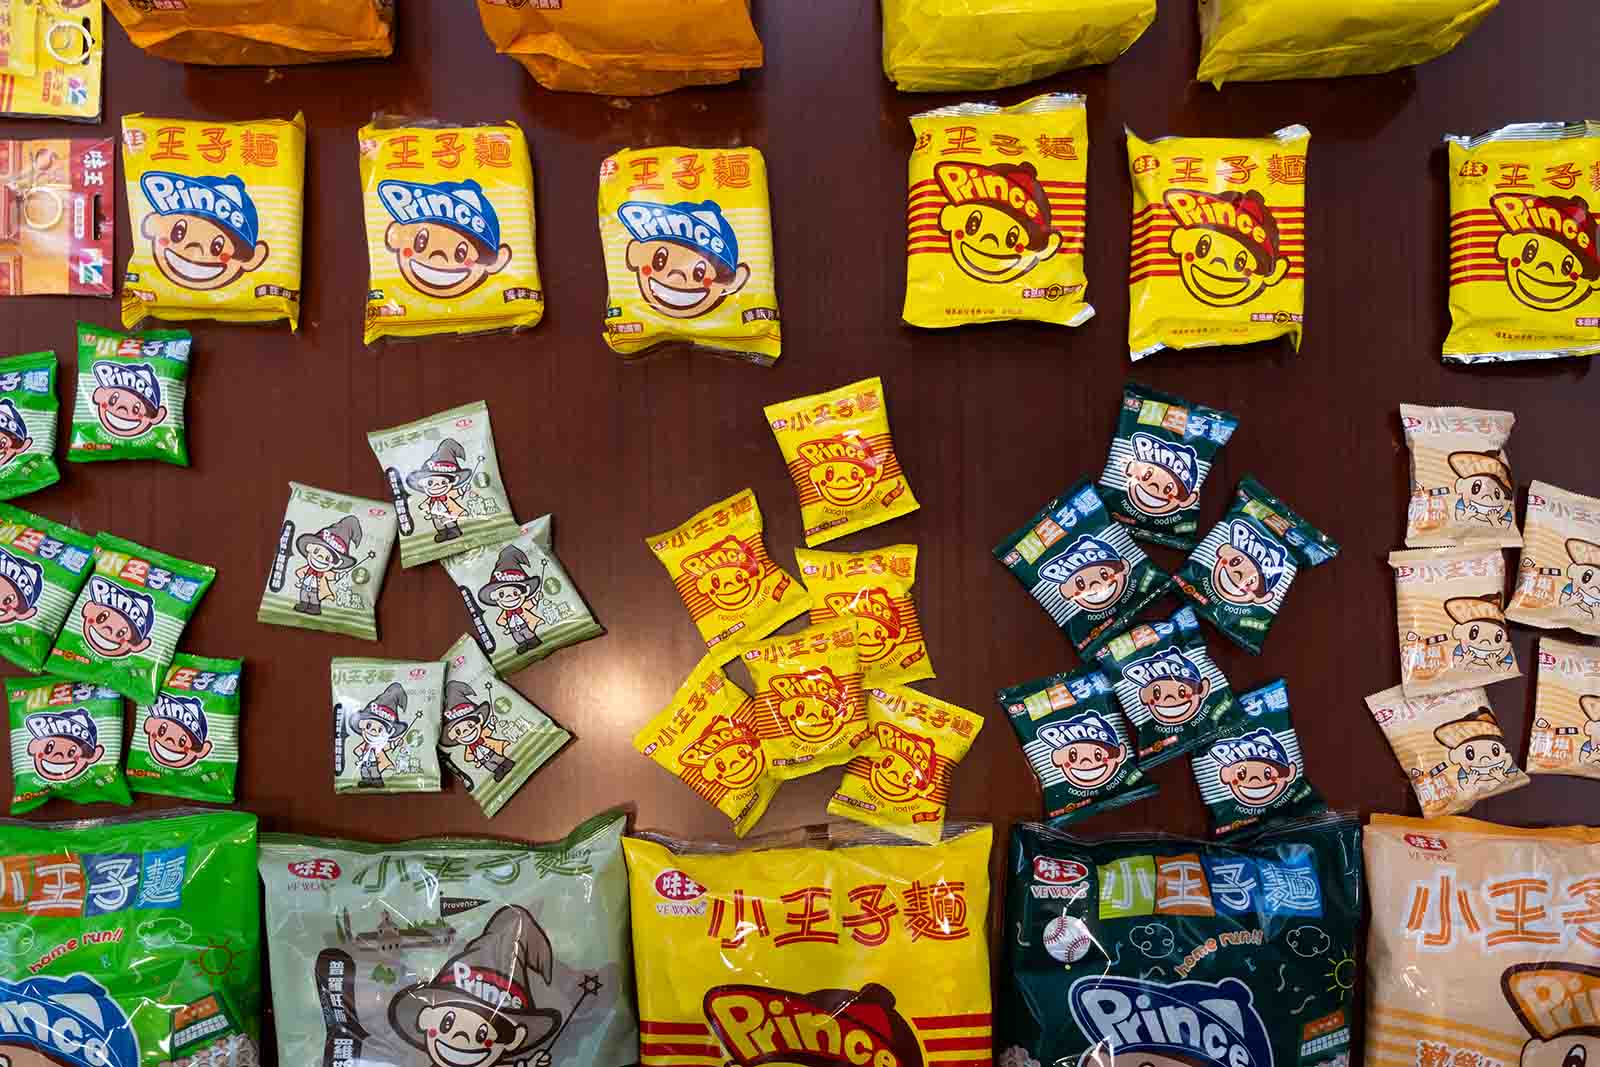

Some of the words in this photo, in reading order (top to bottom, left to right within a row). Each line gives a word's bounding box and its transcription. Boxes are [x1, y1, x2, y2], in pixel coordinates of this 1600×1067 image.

[150, 127, 279, 167] 王子麵
[385, 133, 512, 169] 王子麵
[941, 126, 1078, 160] 王子麵
[627, 154, 752, 192] 王子麵
[1168, 154, 1305, 184] 王子麵
[145, 175, 244, 228] Prince
[381, 186, 485, 232] Prince
[938, 166, 1039, 218] Prince
[621, 207, 724, 253] Prince
[1167, 193, 1266, 243] Prince
[1495, 196, 1590, 248] Prince
[95, 365, 155, 398] Prince
[790, 392, 879, 431] 小王子麵
[1138, 400, 1237, 444] 小王子麵
[429, 461, 457, 473] Prince
[801, 442, 866, 465] Prince
[1135, 439, 1190, 480] Prince
[670, 496, 753, 548] 小王子麵
[1016, 488, 1104, 565] 小王子麵
[1122, 499, 1147, 523] noodles
[1153, 514, 1182, 525] oodles
[322, 529, 346, 553] Prince
[96, 552, 203, 604] 小王子麵
[495, 570, 525, 583] Prince
[684, 553, 747, 577] Prince
[822, 556, 912, 581] 小王子麵
[1042, 549, 1108, 581] Prince
[93, 580, 145, 628] Prince
[830, 595, 891, 621] Prince
[1087, 607, 1117, 621] noodles
[1224, 605, 1252, 616] oodles
[765, 629, 855, 663] 小王子麵
[1108, 606, 1198, 660] 小王子麵
[163, 665, 240, 697] 王子麵
[1128, 660, 1190, 685] Prince
[776, 679, 840, 702] Prince
[1026, 672, 1112, 719] 小王子麵
[370, 704, 396, 721] Prince
[445, 705, 474, 720] Prince
[657, 674, 725, 746] 小王子麵
[886, 696, 973, 738] 小王子麵
[1154, 725, 1184, 734] noodles
[1191, 704, 1212, 727] oodles
[33, 717, 89, 740] Prince
[1040, 724, 1108, 747] Prince
[684, 728, 742, 767] Prince
[878, 728, 929, 767] Prince
[1213, 743, 1277, 766] Prince
[1068, 786, 1099, 797] noodles
[1106, 769, 1127, 790] oodles
[1234, 804, 1266, 815] noodles
[0, 856, 186, 911] 小王子麵
[295, 862, 334, 878] 味王
[663, 873, 700, 896] 味王
[1039, 860, 1081, 879] 味王
[1098, 860, 1322, 912] 小王子麵
[442, 899, 478, 911] Provence
[656, 904, 670, 915] VE
[671, 904, 705, 916] WONG
[708, 880, 970, 949] 小王子麵
[29, 938, 79, 973] home
[82, 928, 125, 946] run!!
[1175, 938, 1217, 978] home
[1218, 929, 1264, 948] run!!
[454, 963, 522, 1009] Prince
[710, 995, 897, 1067] Prince
[1082, 989, 1249, 1067] Prince
